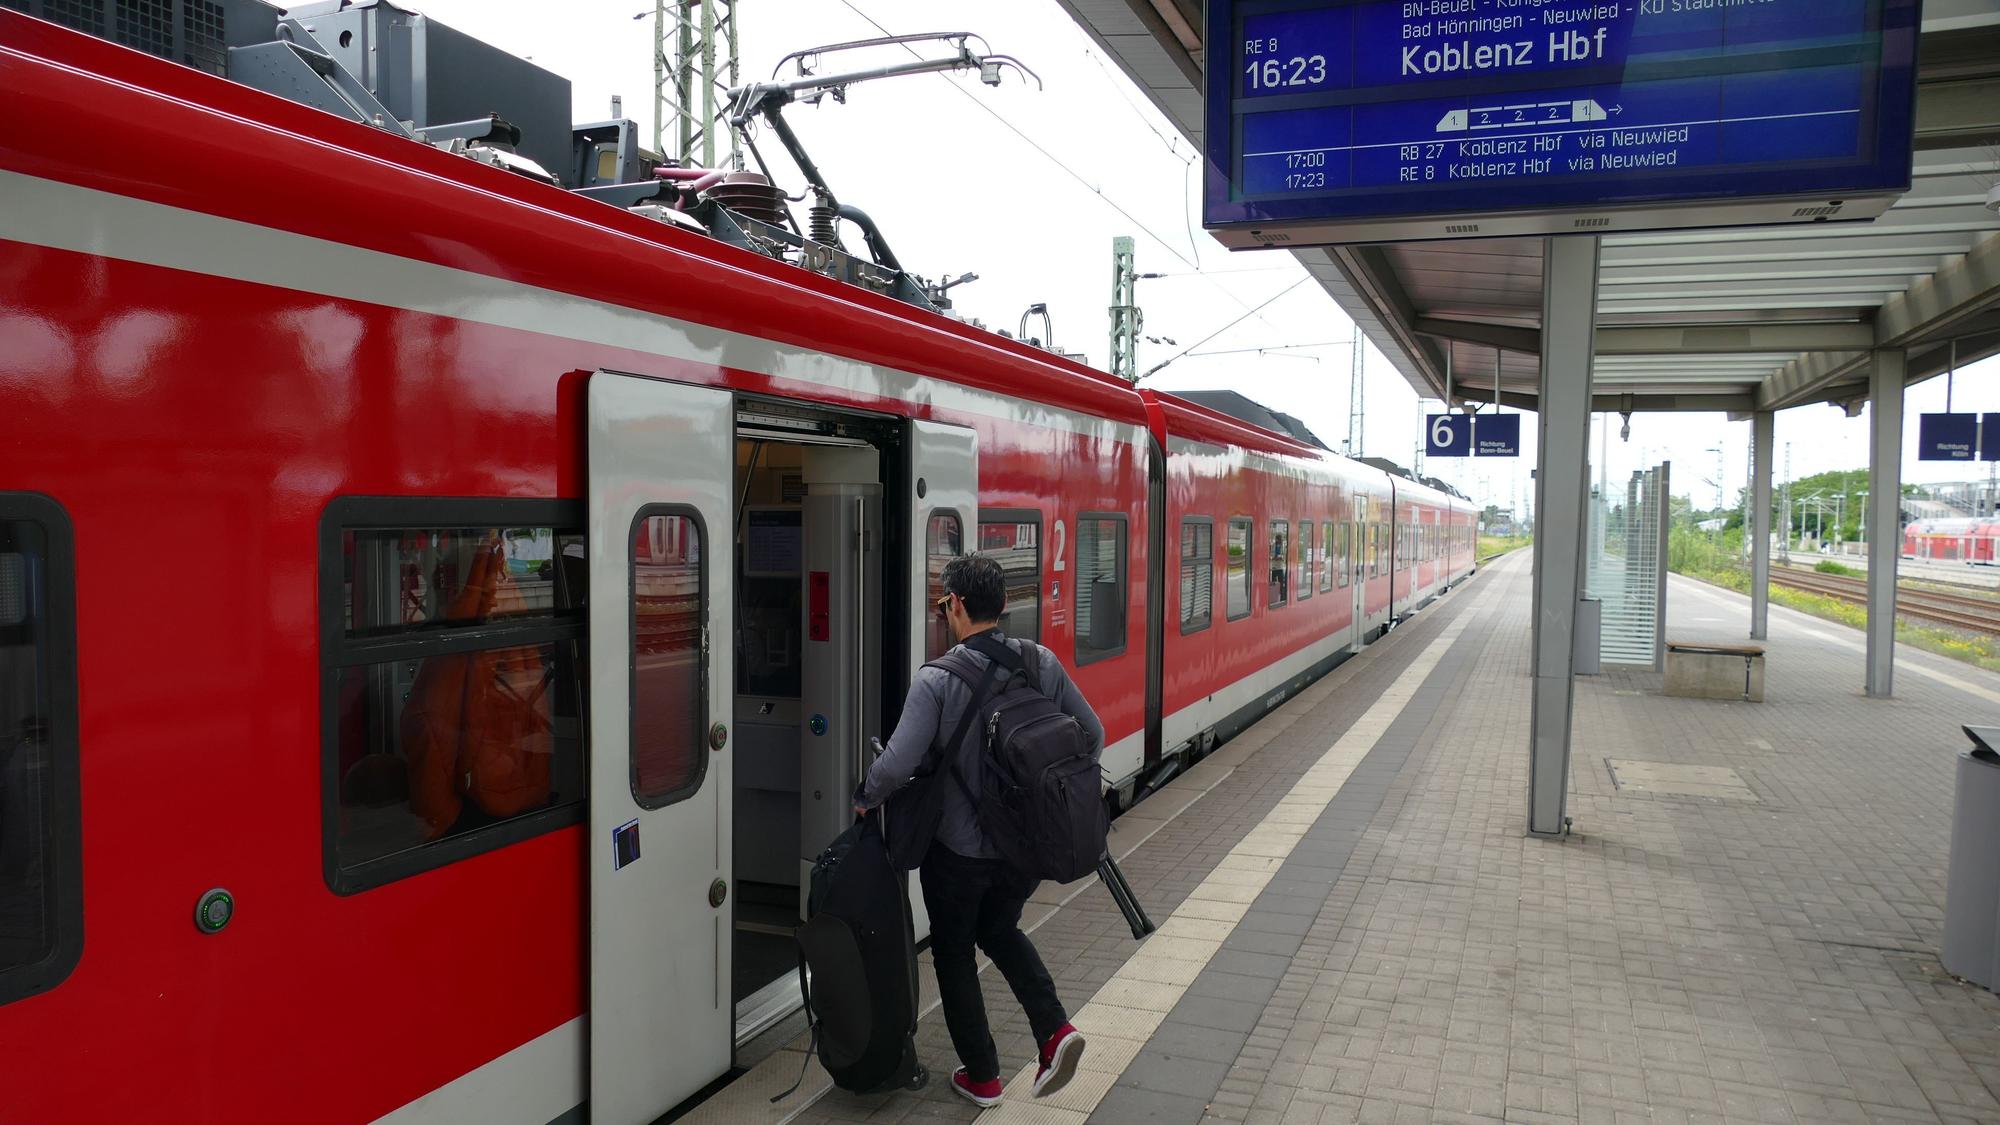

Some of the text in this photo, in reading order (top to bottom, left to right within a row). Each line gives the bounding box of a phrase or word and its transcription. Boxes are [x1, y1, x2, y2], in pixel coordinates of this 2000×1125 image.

[1402, 22, 1431, 39] Bad
[1437, 15, 1523, 33] Hönningen
[1543, 4, 1619, 25] Neuwied
[1403, 0, 1476, 18] BN-Beuel
[1245, 37, 1278, 55] RE 8
[1402, 26, 1608, 76] Koblenz Hbf
[1245, 54, 1326, 89] 16:23
[1480, 112, 1491, 124] 2.
[1514, 110, 1525, 121] 2.
[1548, 107, 1559, 119] 2.
[1400, 126, 1689, 161] RB 27 Koblenz Hbf via Neuwied
[1285, 152, 1325, 169] 17:00
[1400, 149, 1677, 182] RE 8 Koblenz Hbf via Neuwied
[1285, 172, 1325, 189] 17:23
[1431, 415, 1454, 448] 6
[1053, 519, 1066, 571] 2
